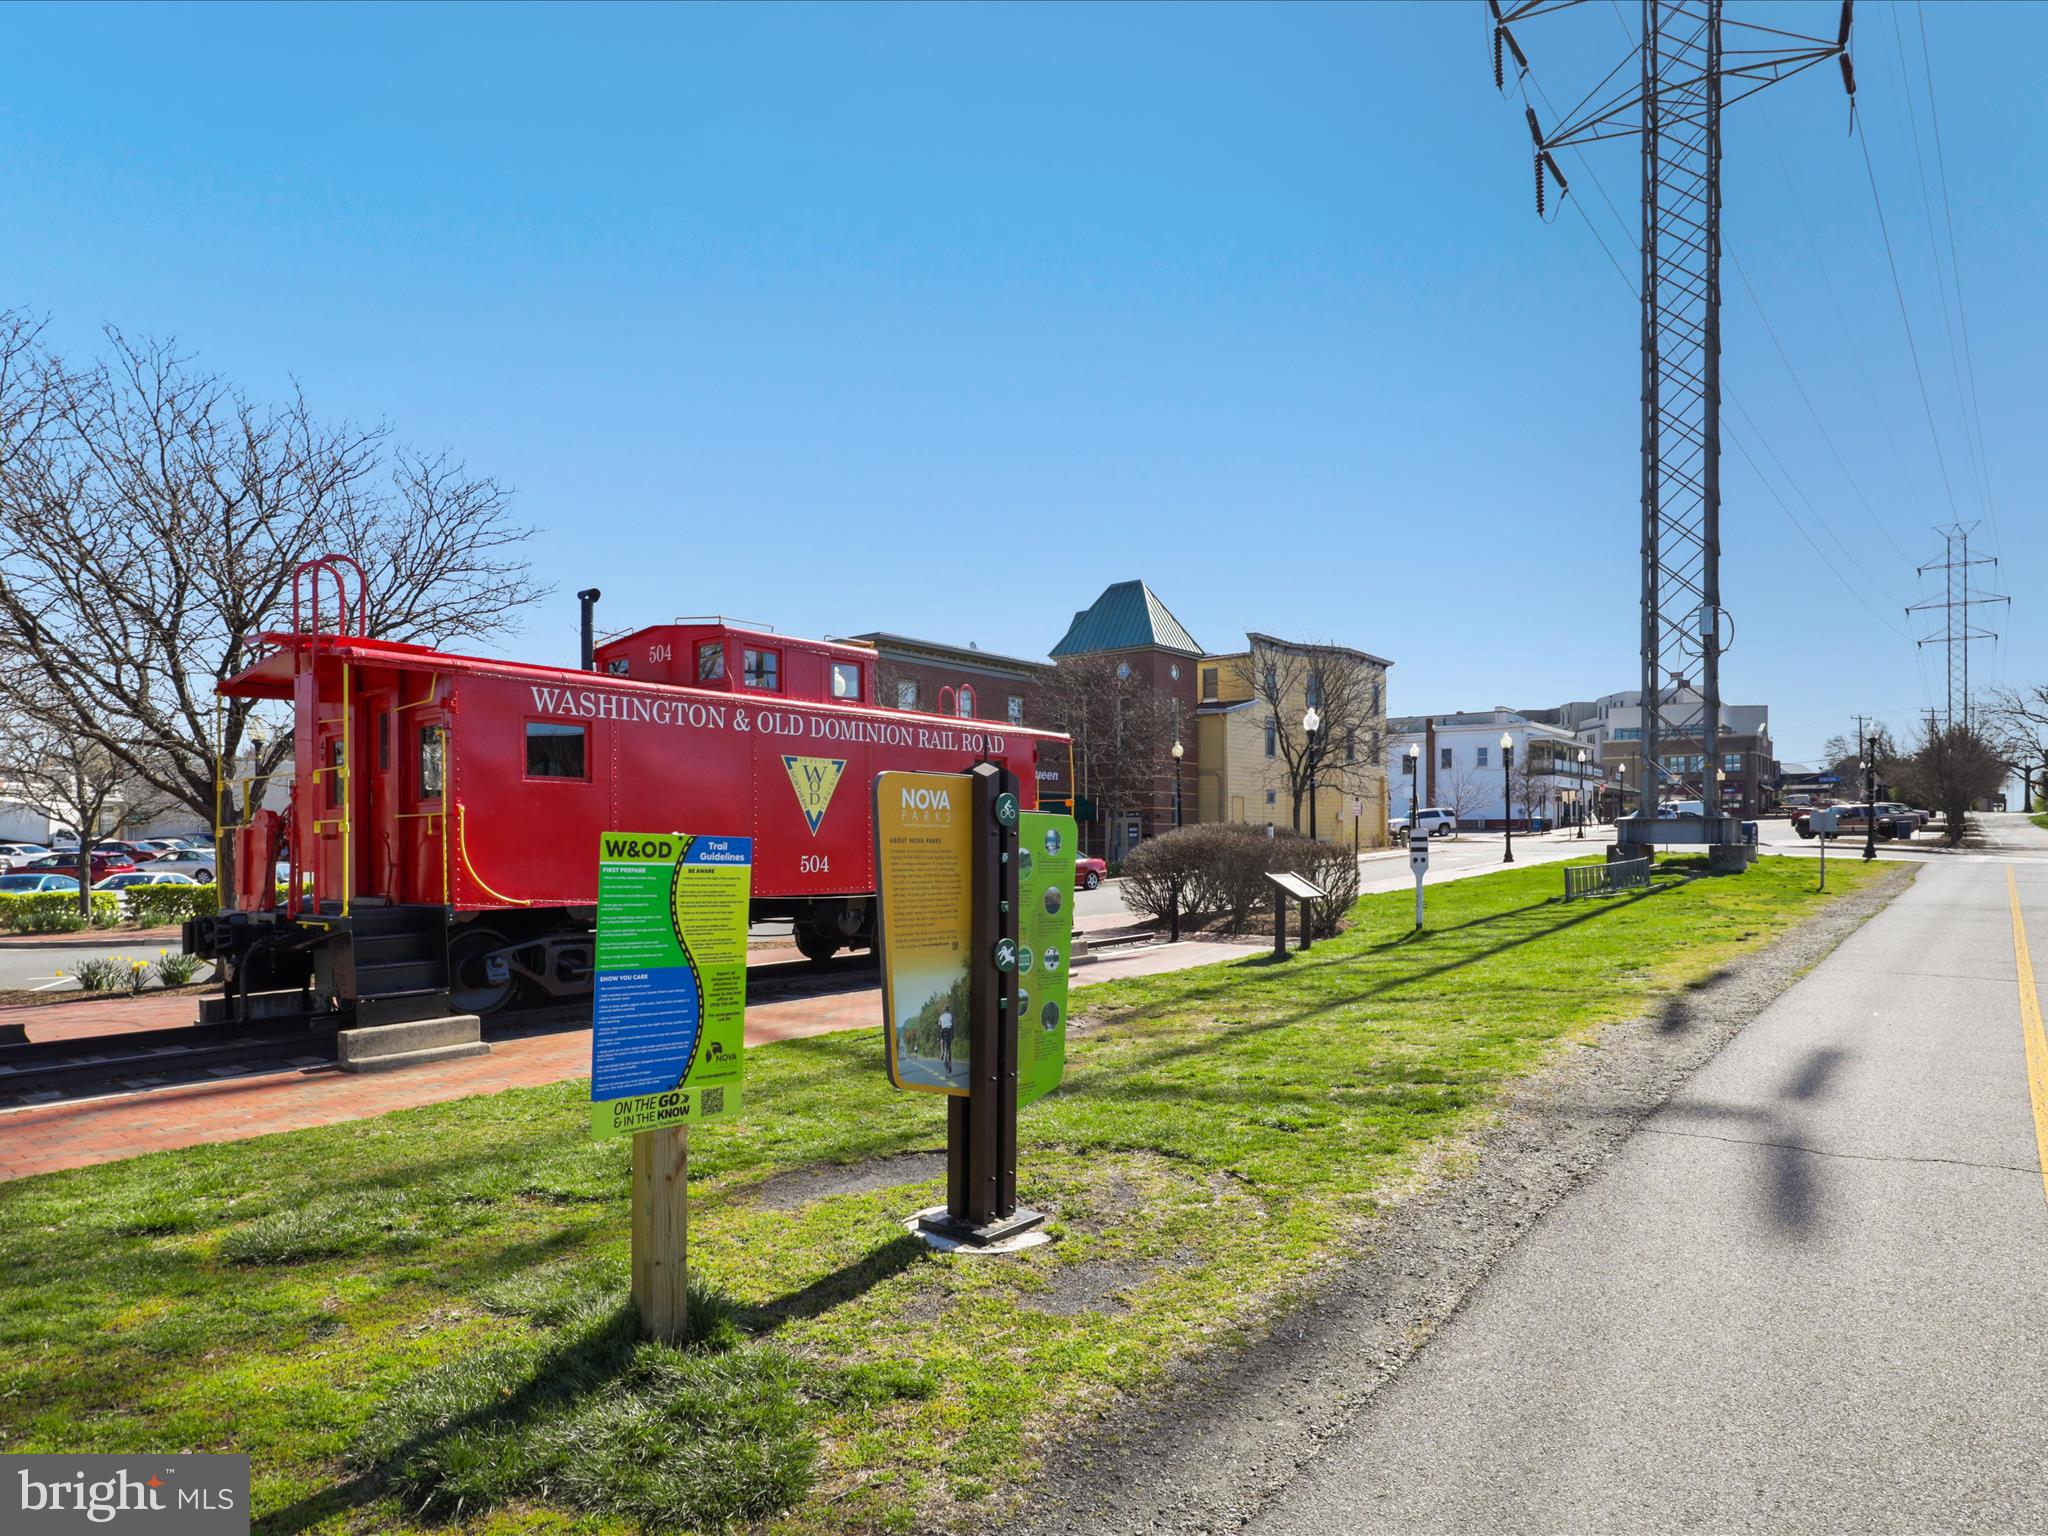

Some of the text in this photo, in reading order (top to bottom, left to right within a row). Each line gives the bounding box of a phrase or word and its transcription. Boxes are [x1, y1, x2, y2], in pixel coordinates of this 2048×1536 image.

[649, 644, 672, 664] 504
[530, 686, 1005, 754] WASHINGTON & OLD DOMINION RAIL ROAD
[901, 787, 951, 810] NOVA
[901, 810, 951, 823] PARKS
[605, 839, 672, 859] W&OD
[708, 842, 728, 851] Trail
[700, 852, 745, 862] Guidelines
[800, 855, 829, 873] 504
[614, 1093, 680, 1116] ON THE GO
[613, 1105, 690, 1128] & IN THE KNOW
